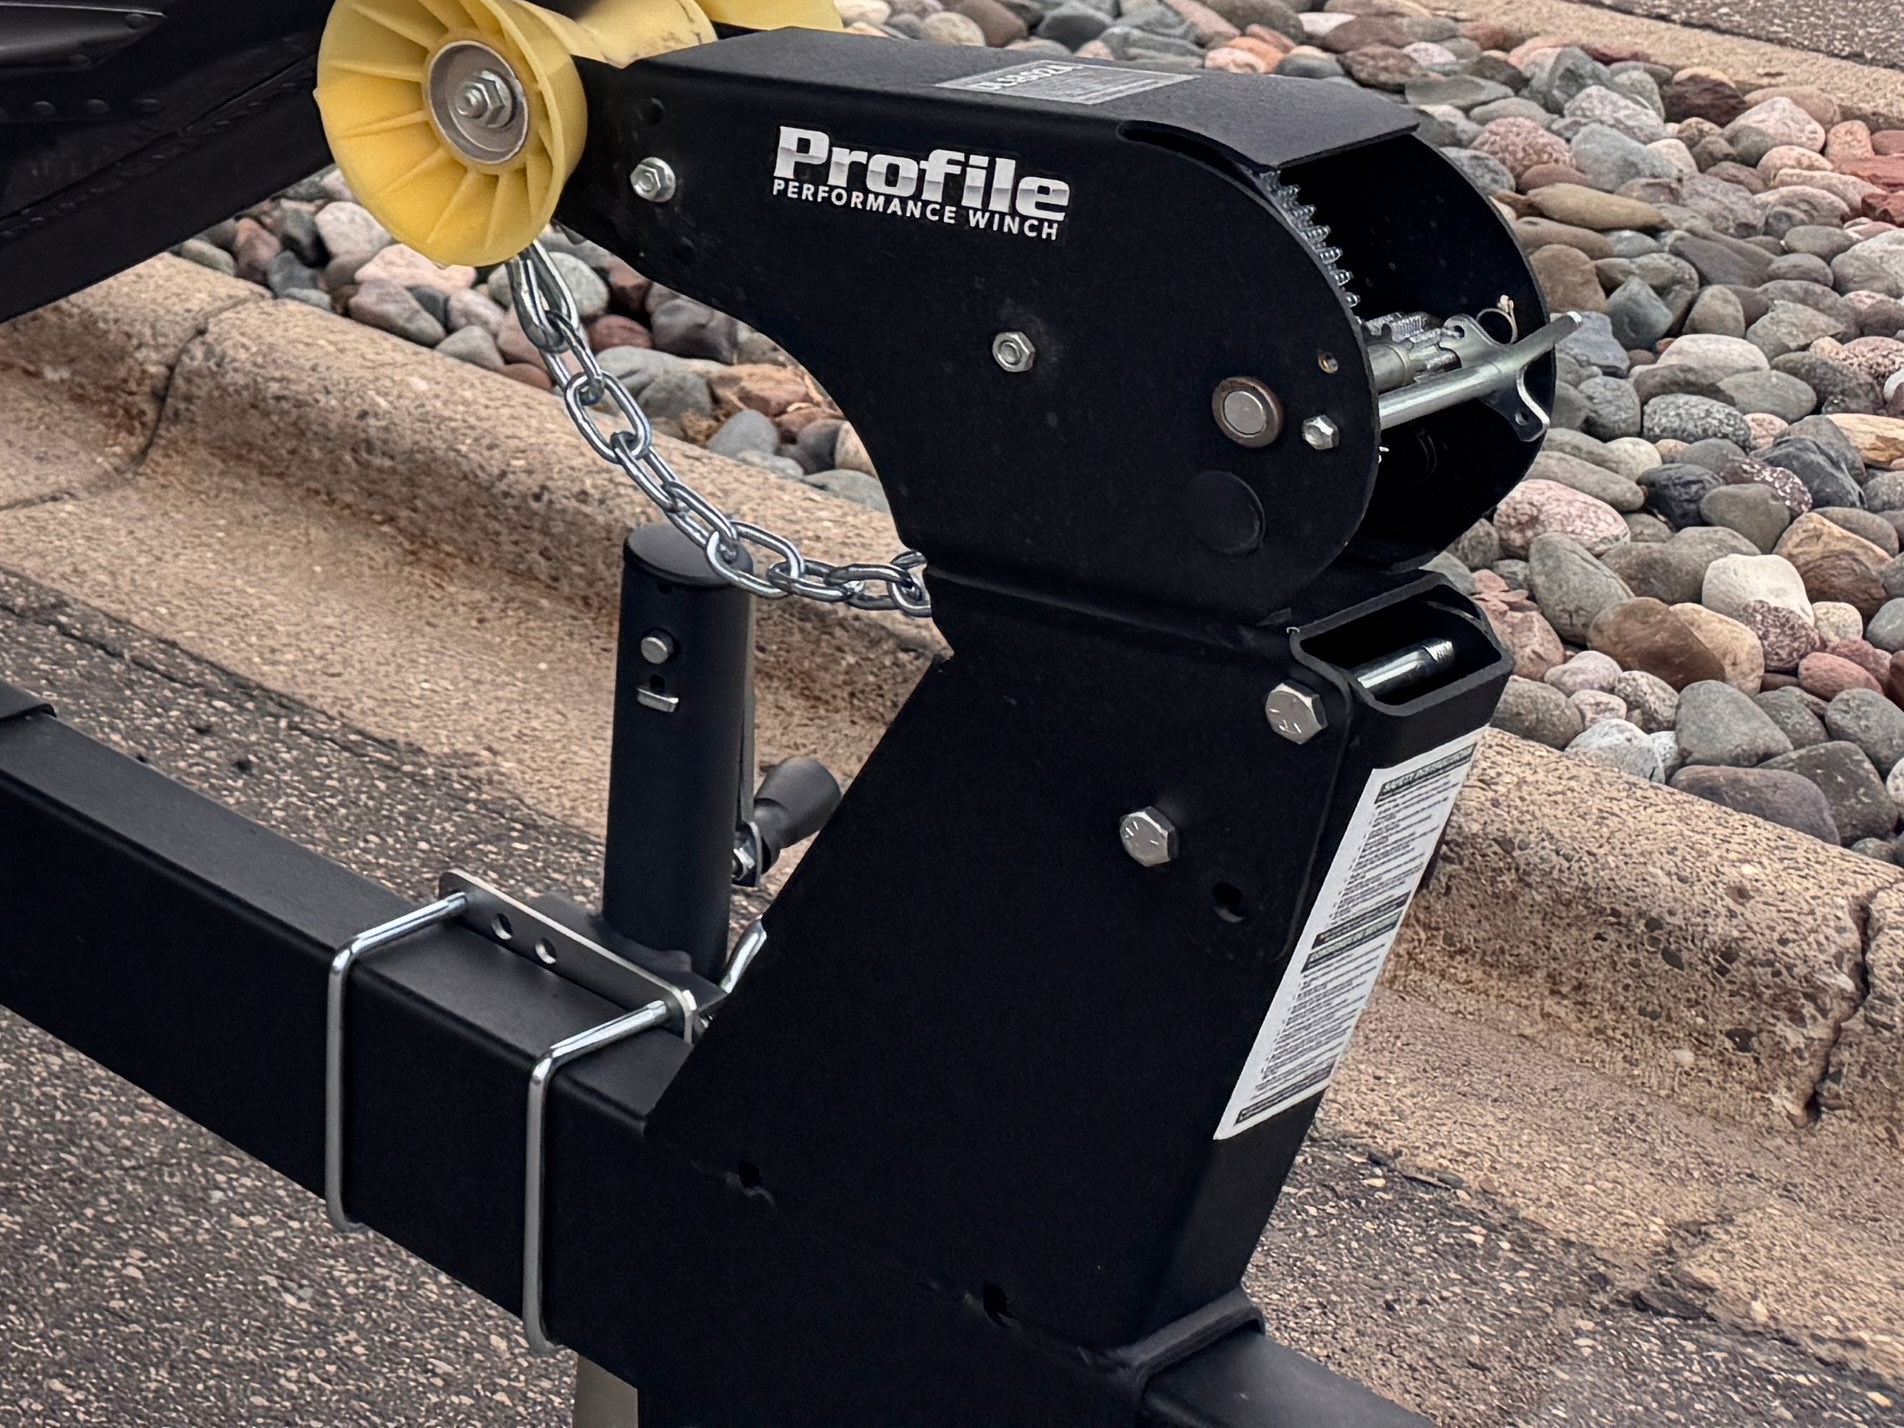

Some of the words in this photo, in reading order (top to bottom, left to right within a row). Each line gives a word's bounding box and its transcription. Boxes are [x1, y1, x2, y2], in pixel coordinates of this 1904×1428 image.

[772, 179, 957, 224] PERFORMANCE
[968, 209, 1059, 241] WINCH
[773, 126, 1070, 221] Profile
